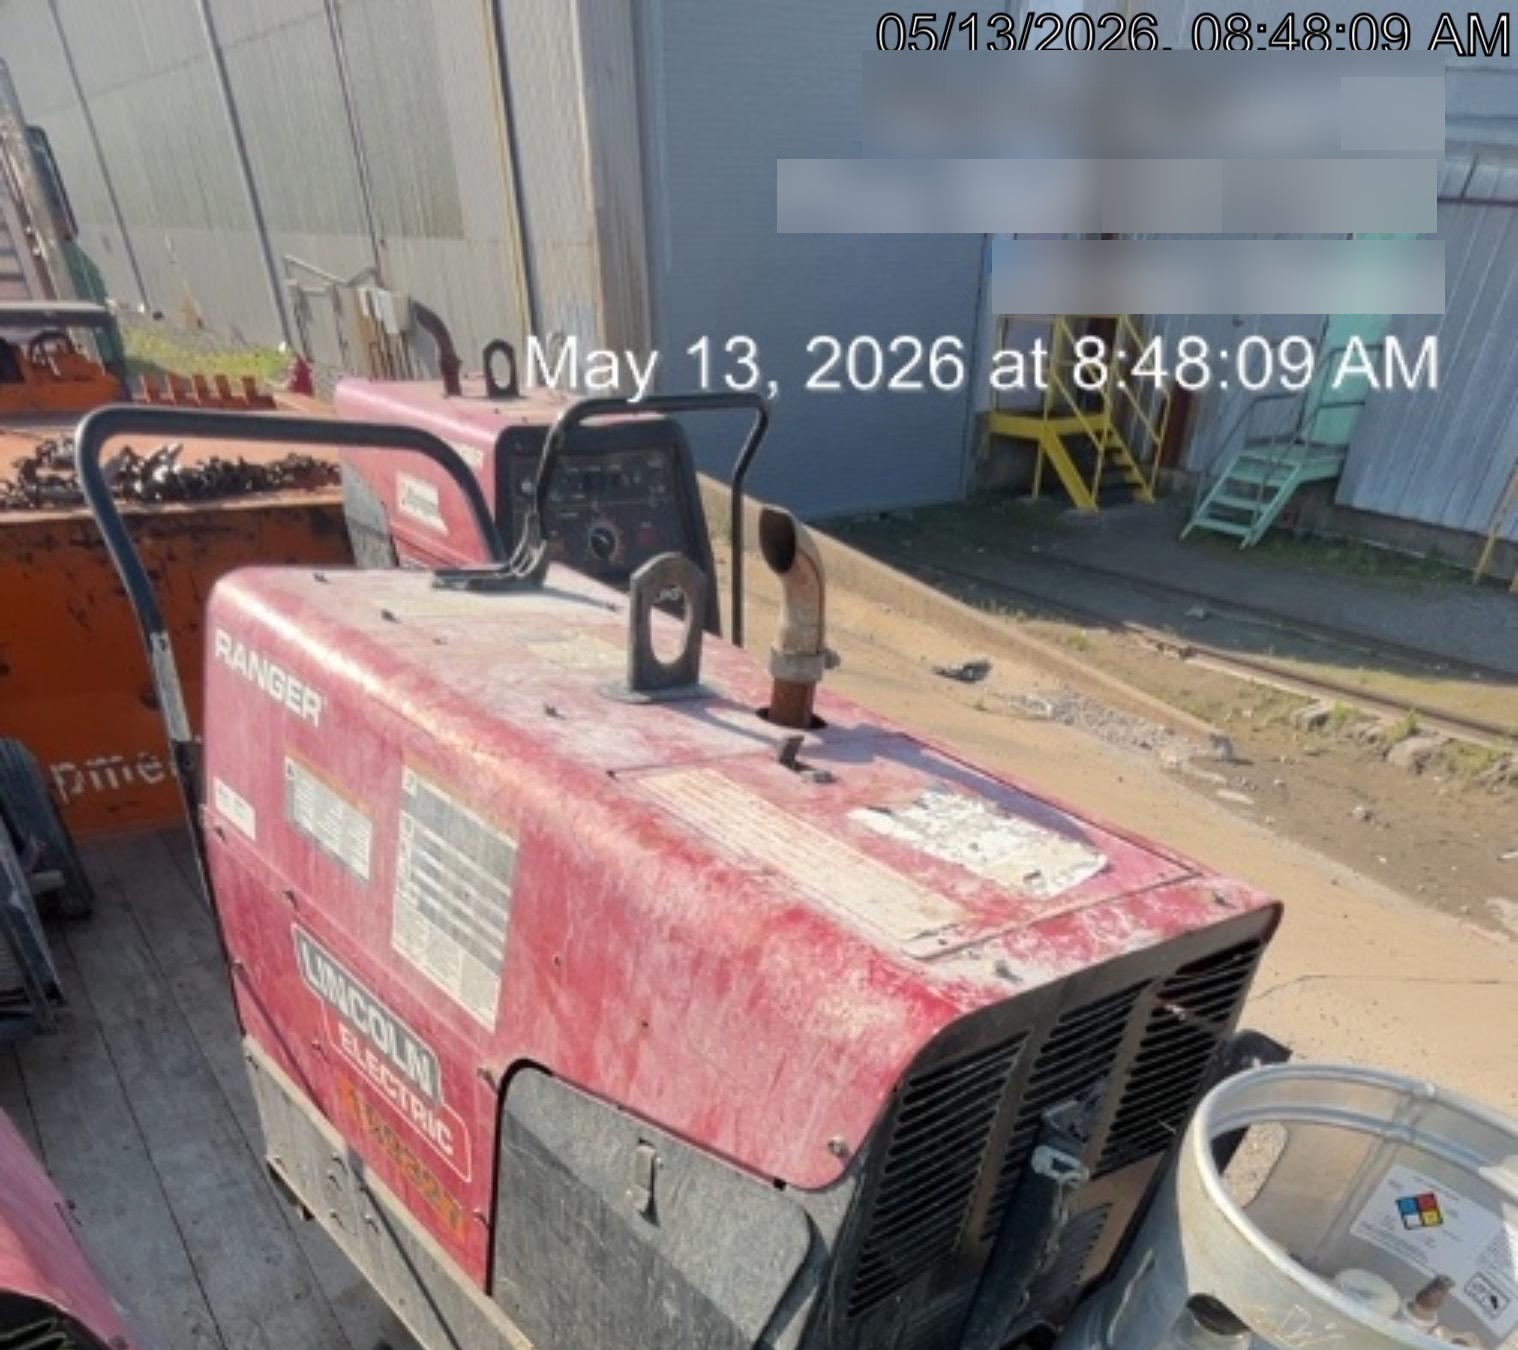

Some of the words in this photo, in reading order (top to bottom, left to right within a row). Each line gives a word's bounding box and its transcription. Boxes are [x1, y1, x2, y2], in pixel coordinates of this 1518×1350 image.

[215, 627, 322, 728] RANGER
[302, 941, 435, 1100] LINCOLN
[338, 1022, 455, 1157] ELECTRIC
